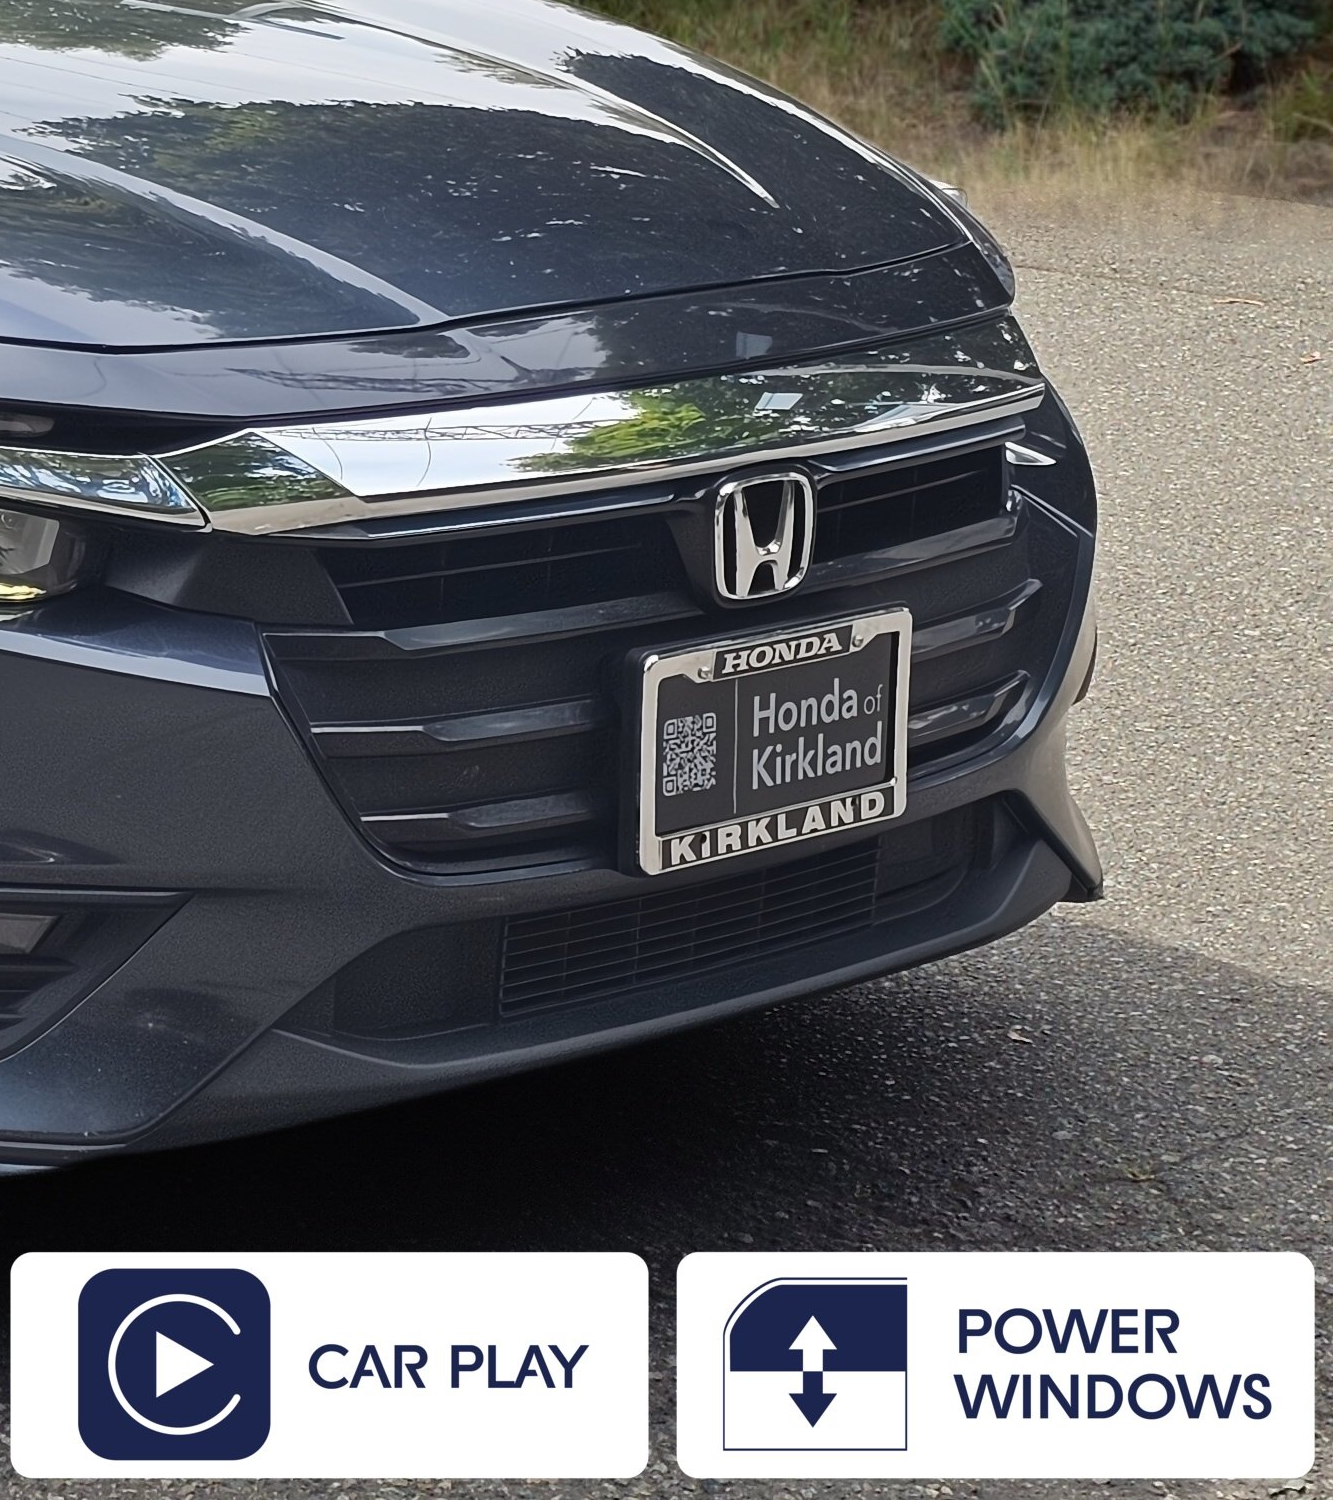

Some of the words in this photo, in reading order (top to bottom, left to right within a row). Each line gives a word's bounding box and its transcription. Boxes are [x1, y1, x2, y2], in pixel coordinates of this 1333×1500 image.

[721, 632, 842, 674] HONDA
[753, 677, 858, 737] Honda
[863, 683, 883, 715] of
[752, 720, 882, 790] Kirkland
[670, 791, 885, 866] KIRKLAND
